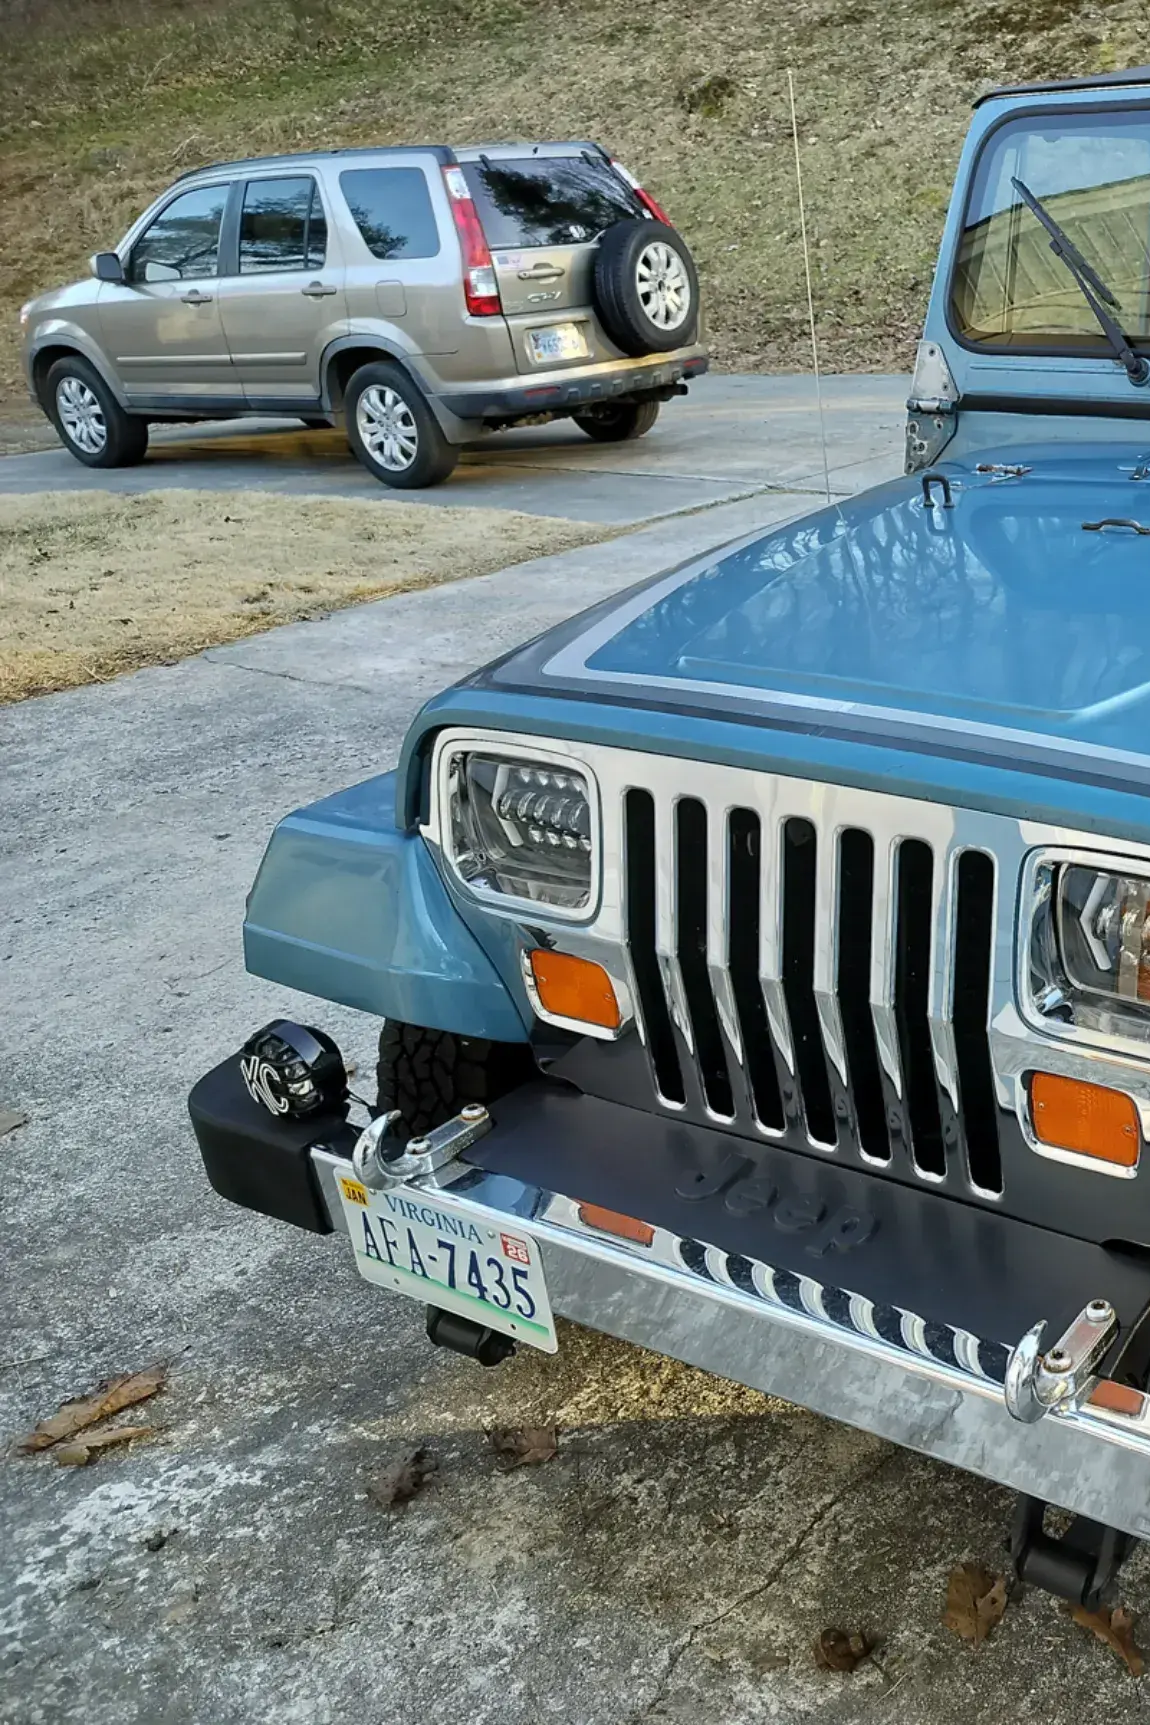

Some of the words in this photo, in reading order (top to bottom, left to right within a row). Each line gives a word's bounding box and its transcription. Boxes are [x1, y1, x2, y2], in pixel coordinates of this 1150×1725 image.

[239, 1055, 289, 1116] KC
[345, 1187, 368, 1206] JAN
[384, 1193, 484, 1245] VIRGINIA
[674, 1153, 882, 1259] Jeep
[361, 1211, 536, 1319] AFA-7435
